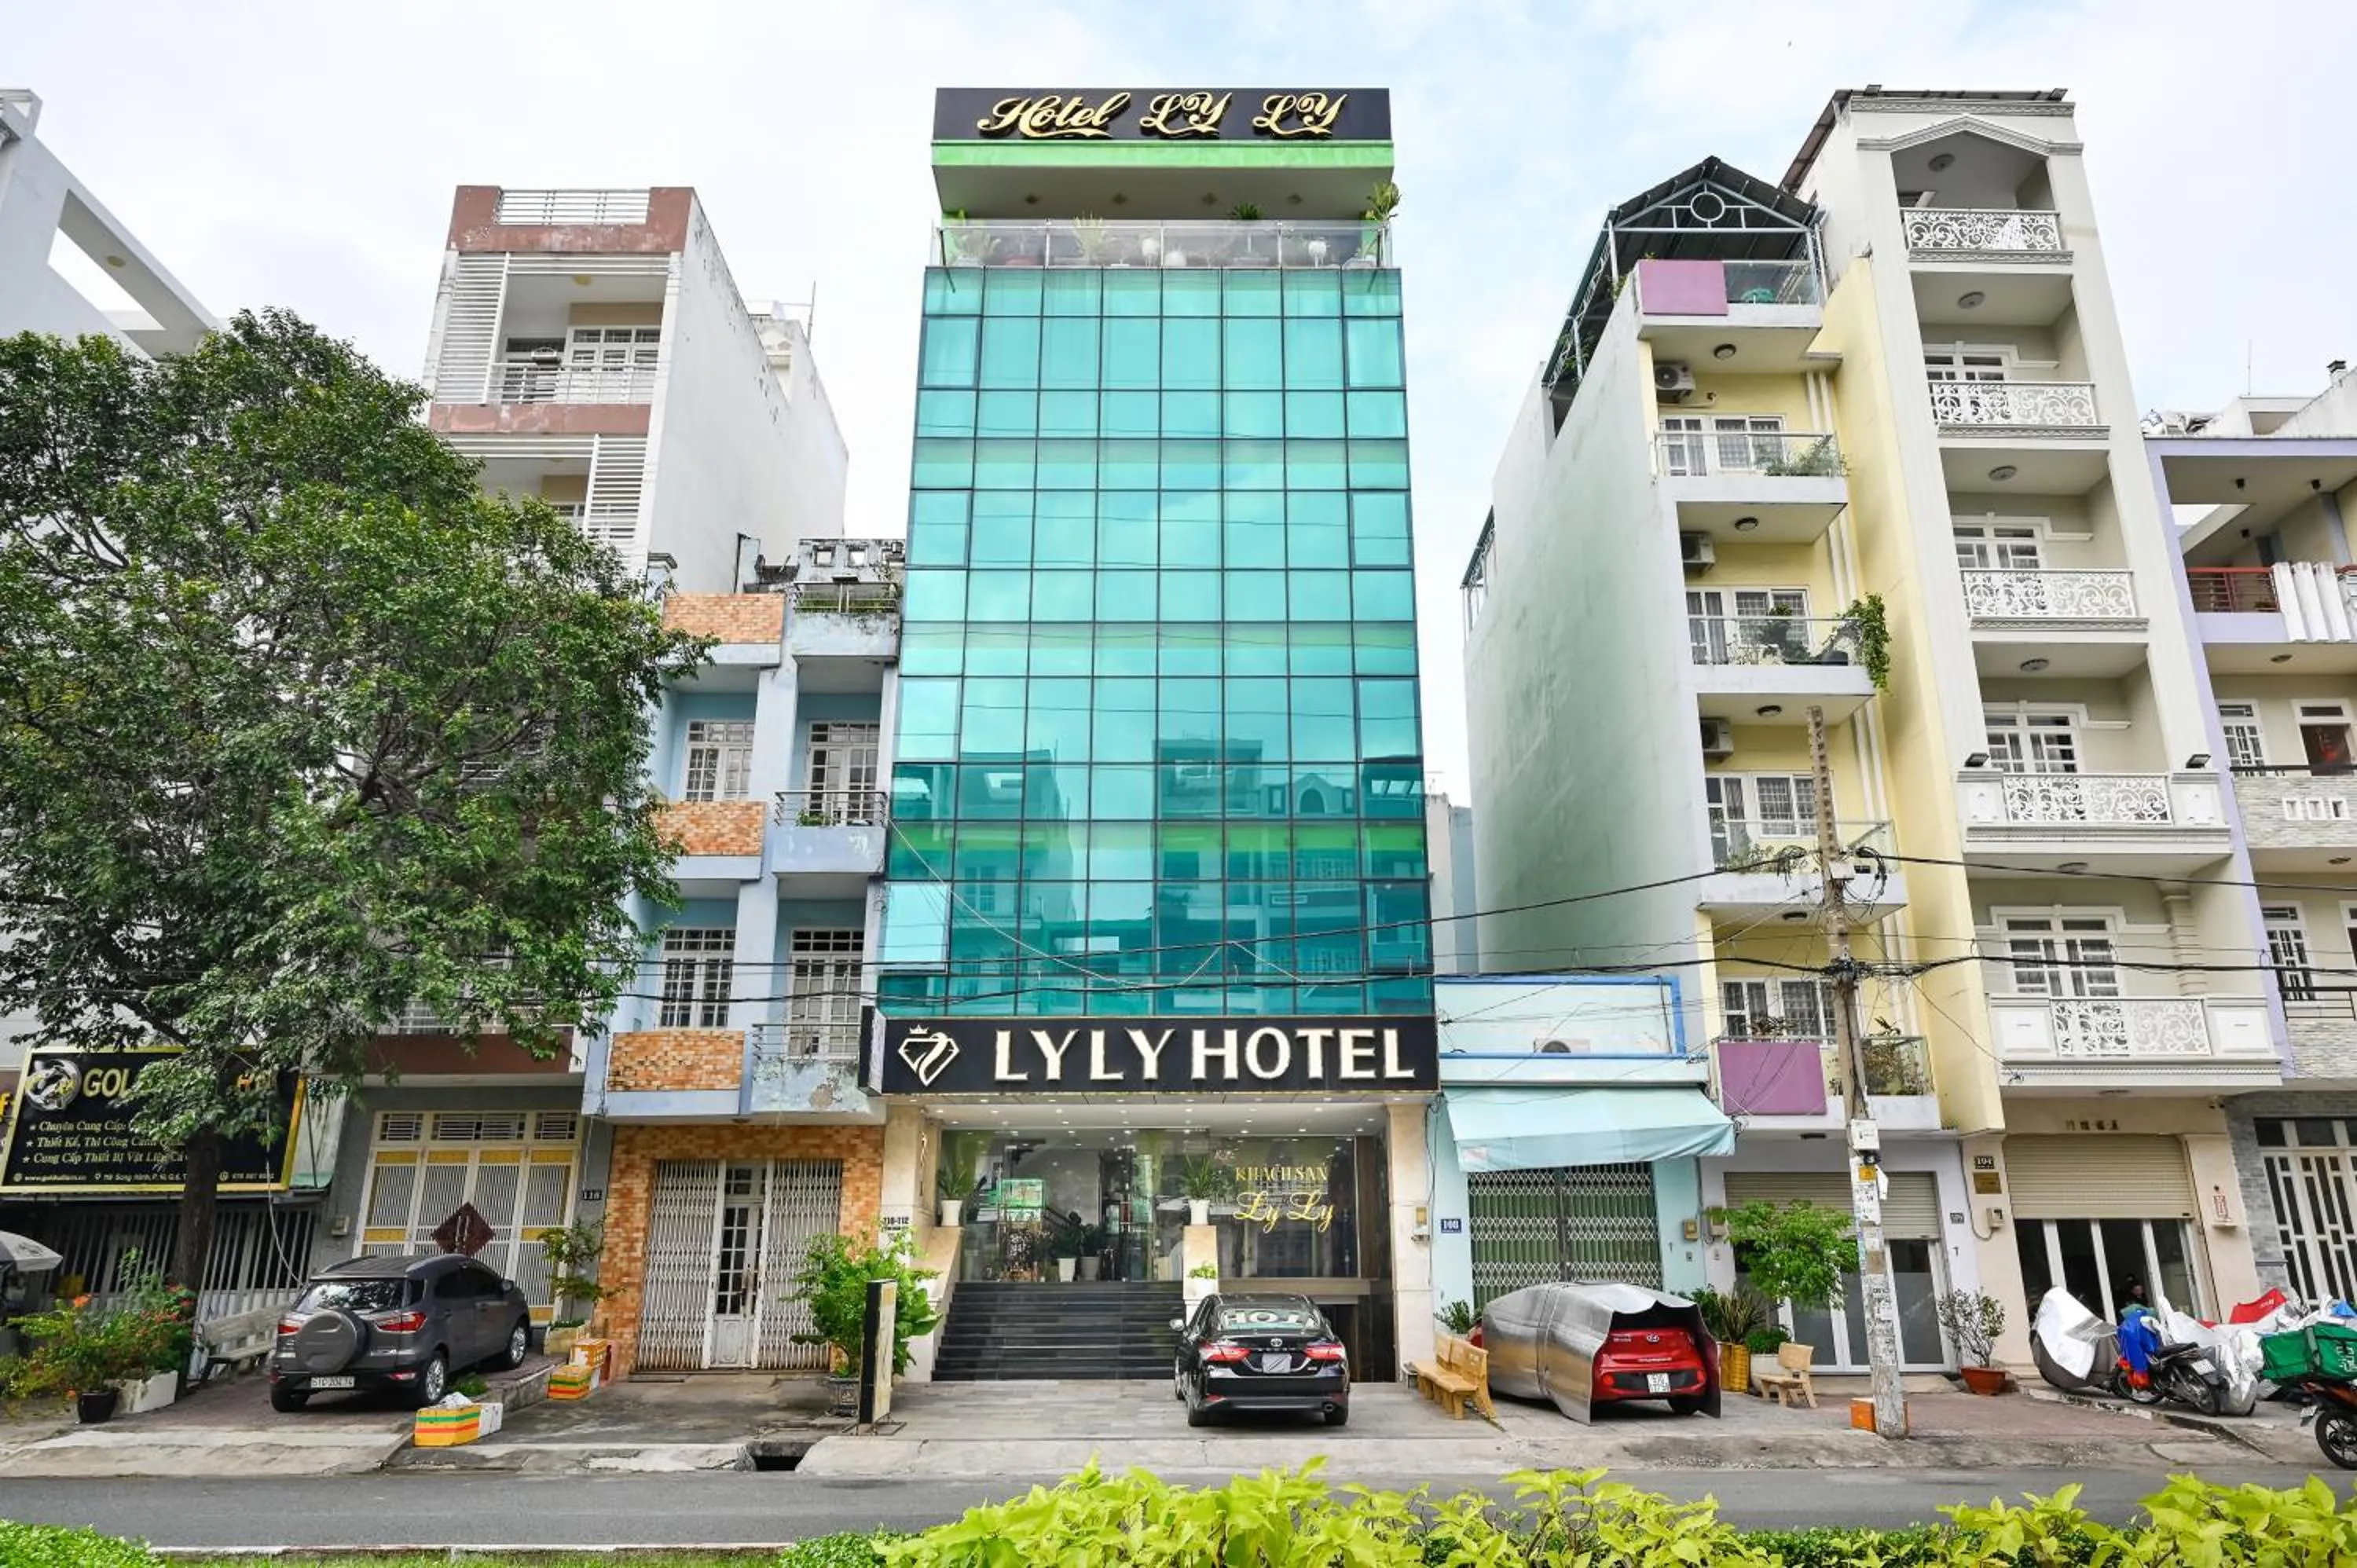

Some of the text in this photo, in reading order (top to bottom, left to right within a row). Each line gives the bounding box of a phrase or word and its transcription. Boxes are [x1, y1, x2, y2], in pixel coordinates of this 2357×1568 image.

[977, 91, 1131, 138] Hotel
[1190, 1027, 1416, 1080] HOTEL
[82, 1068, 134, 1098] GOL
